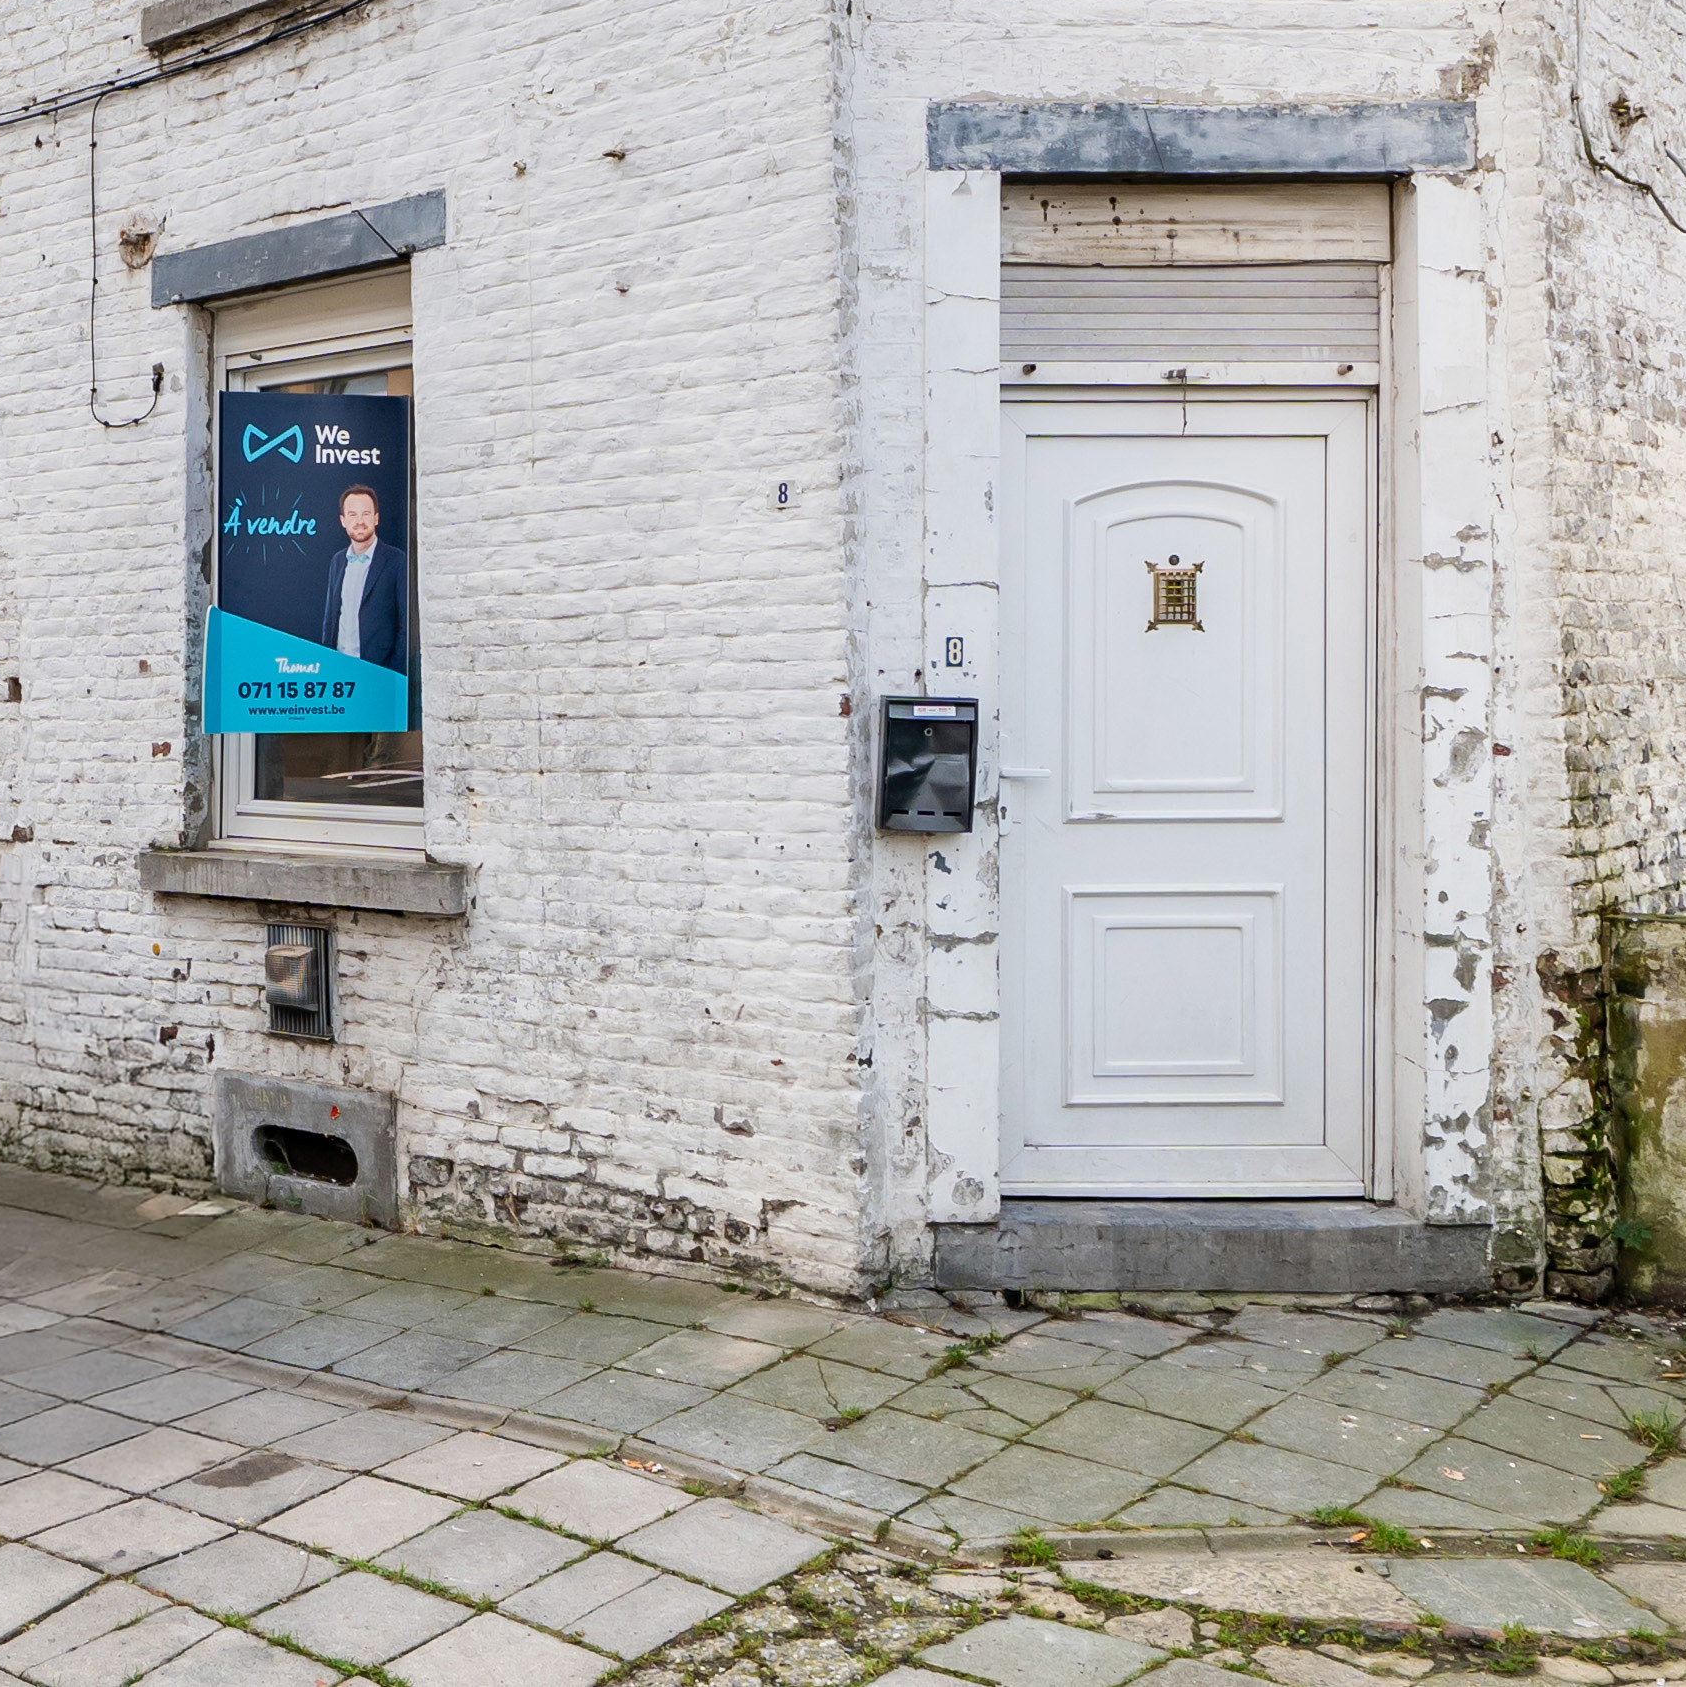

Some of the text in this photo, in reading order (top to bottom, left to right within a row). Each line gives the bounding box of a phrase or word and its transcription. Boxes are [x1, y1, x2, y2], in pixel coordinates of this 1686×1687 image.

[315, 424, 350, 445] We
[315, 444, 380, 465] Invest
[778, 482, 788, 504] 8
[224, 497, 317, 536] À vendre
[948, 638, 962, 665] 8
[275, 657, 321, 674] Thomas
[238, 681, 356, 699] 071 15 87 87
[248, 704, 346, 715] www.weinvest.be
